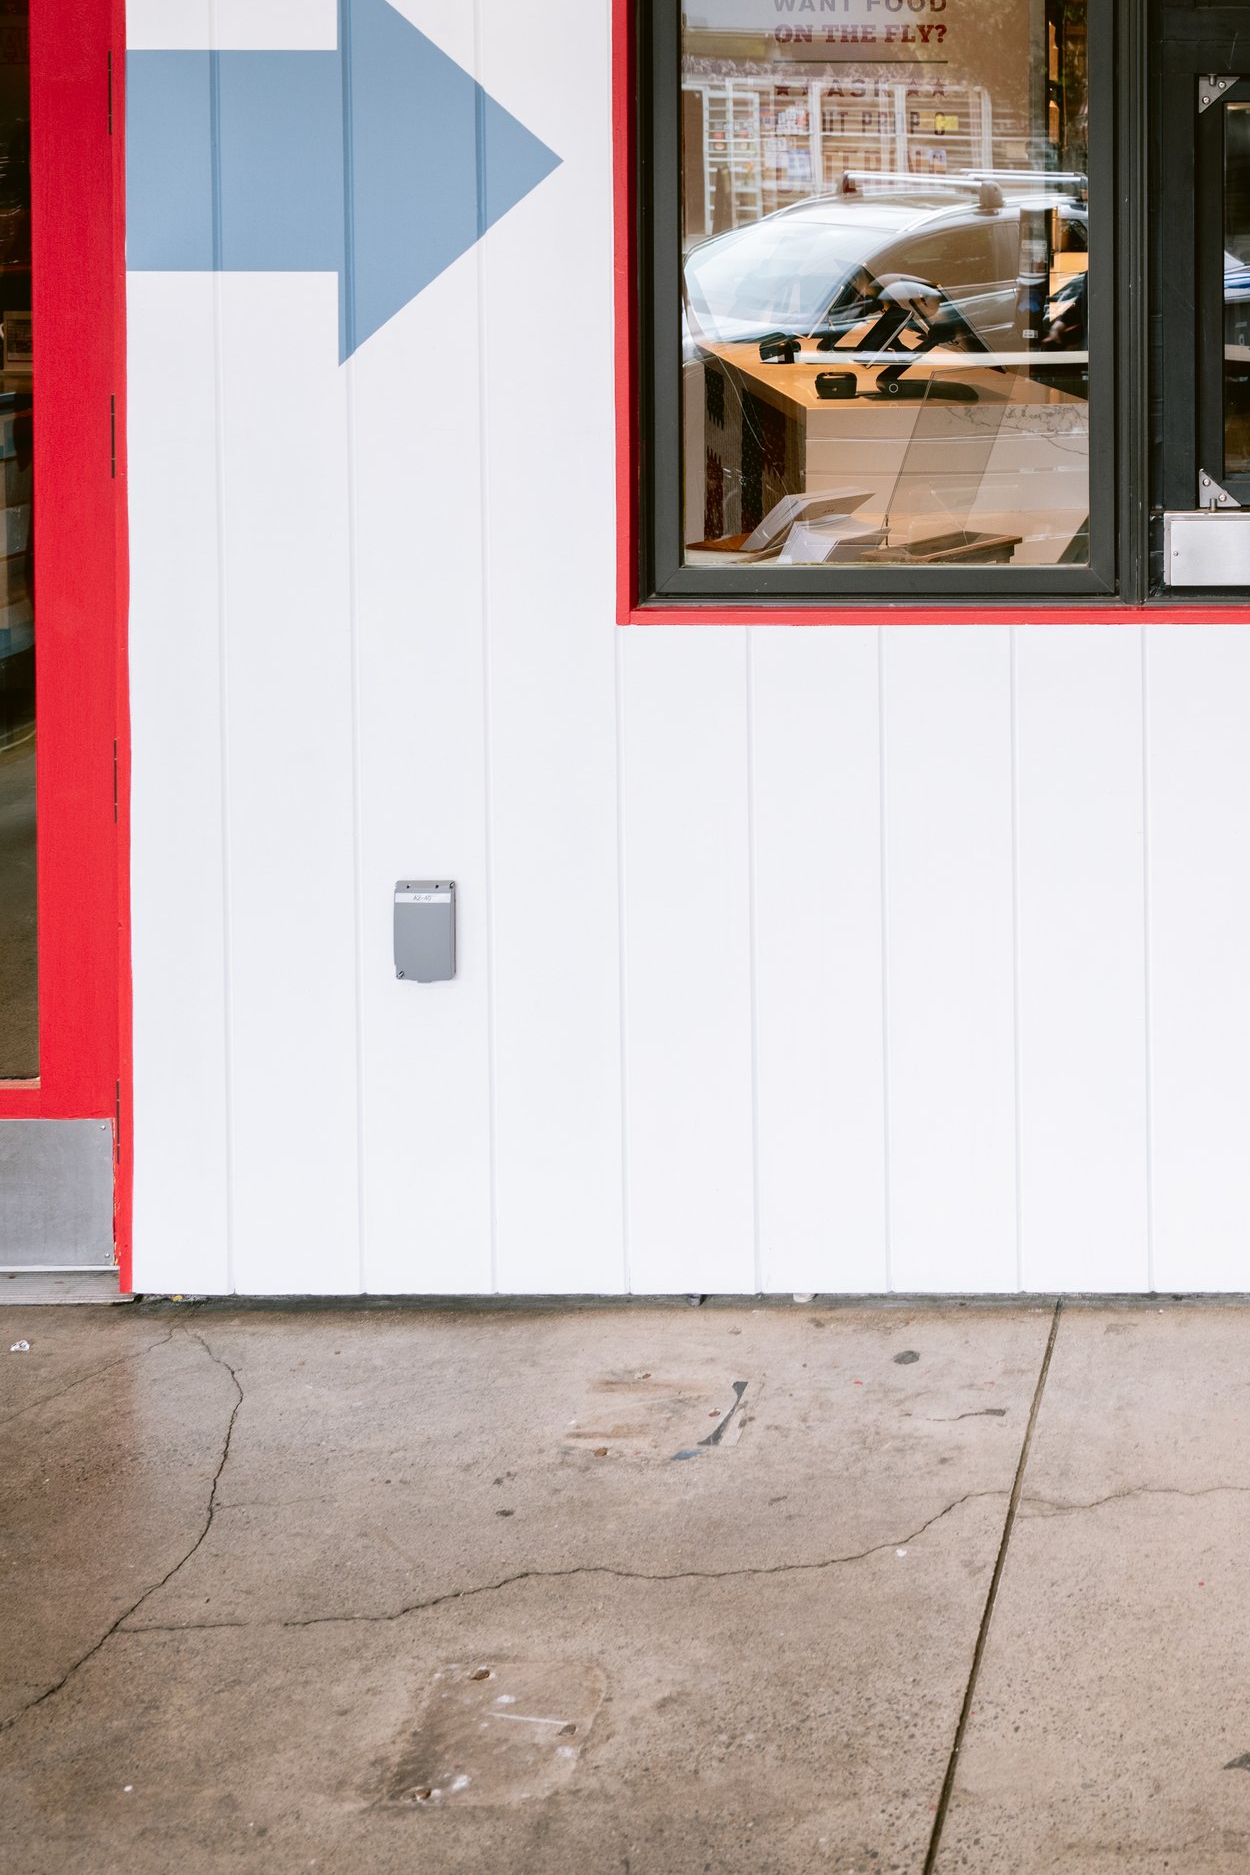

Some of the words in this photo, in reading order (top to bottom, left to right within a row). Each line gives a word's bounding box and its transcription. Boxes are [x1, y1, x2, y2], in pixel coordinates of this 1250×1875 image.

[774, 24, 814, 43] ON
[822, 24, 877, 43] THE
[884, 24, 948, 43] FLY?
[827, 78, 892, 98] ASK
